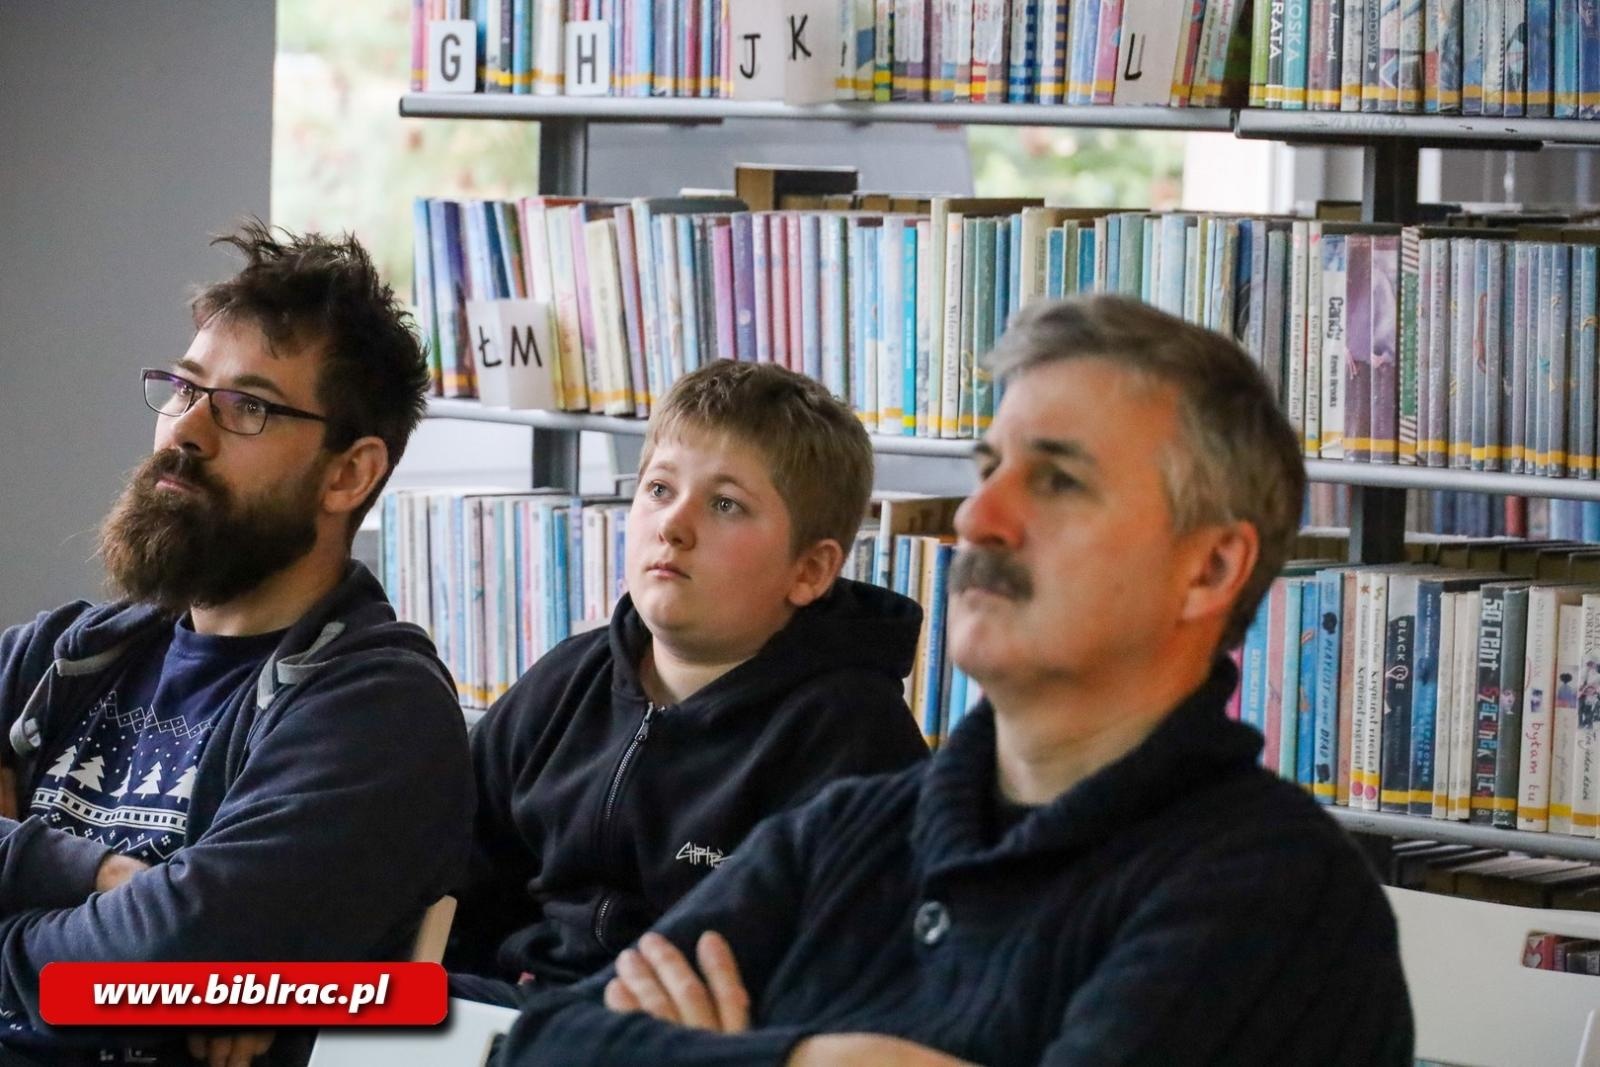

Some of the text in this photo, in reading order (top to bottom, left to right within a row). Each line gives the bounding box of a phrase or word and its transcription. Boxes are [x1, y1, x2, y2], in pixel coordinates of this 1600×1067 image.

[439, 32, 461, 82] G
[576, 34, 597, 84] H
[739, 33, 761, 79] J
[789, 14, 812, 62] K
[1326, 296, 1344, 341] Candy
[1329, 379, 1339, 408] Brooks
[1481, 598, 1504, 622] 50
[1584, 605, 1593, 656] FORMAN
[1395, 620, 1408, 661] BLACK
[1322, 638, 1333, 692] PLAYLIST
[1319, 729, 1330, 759] DEAD
